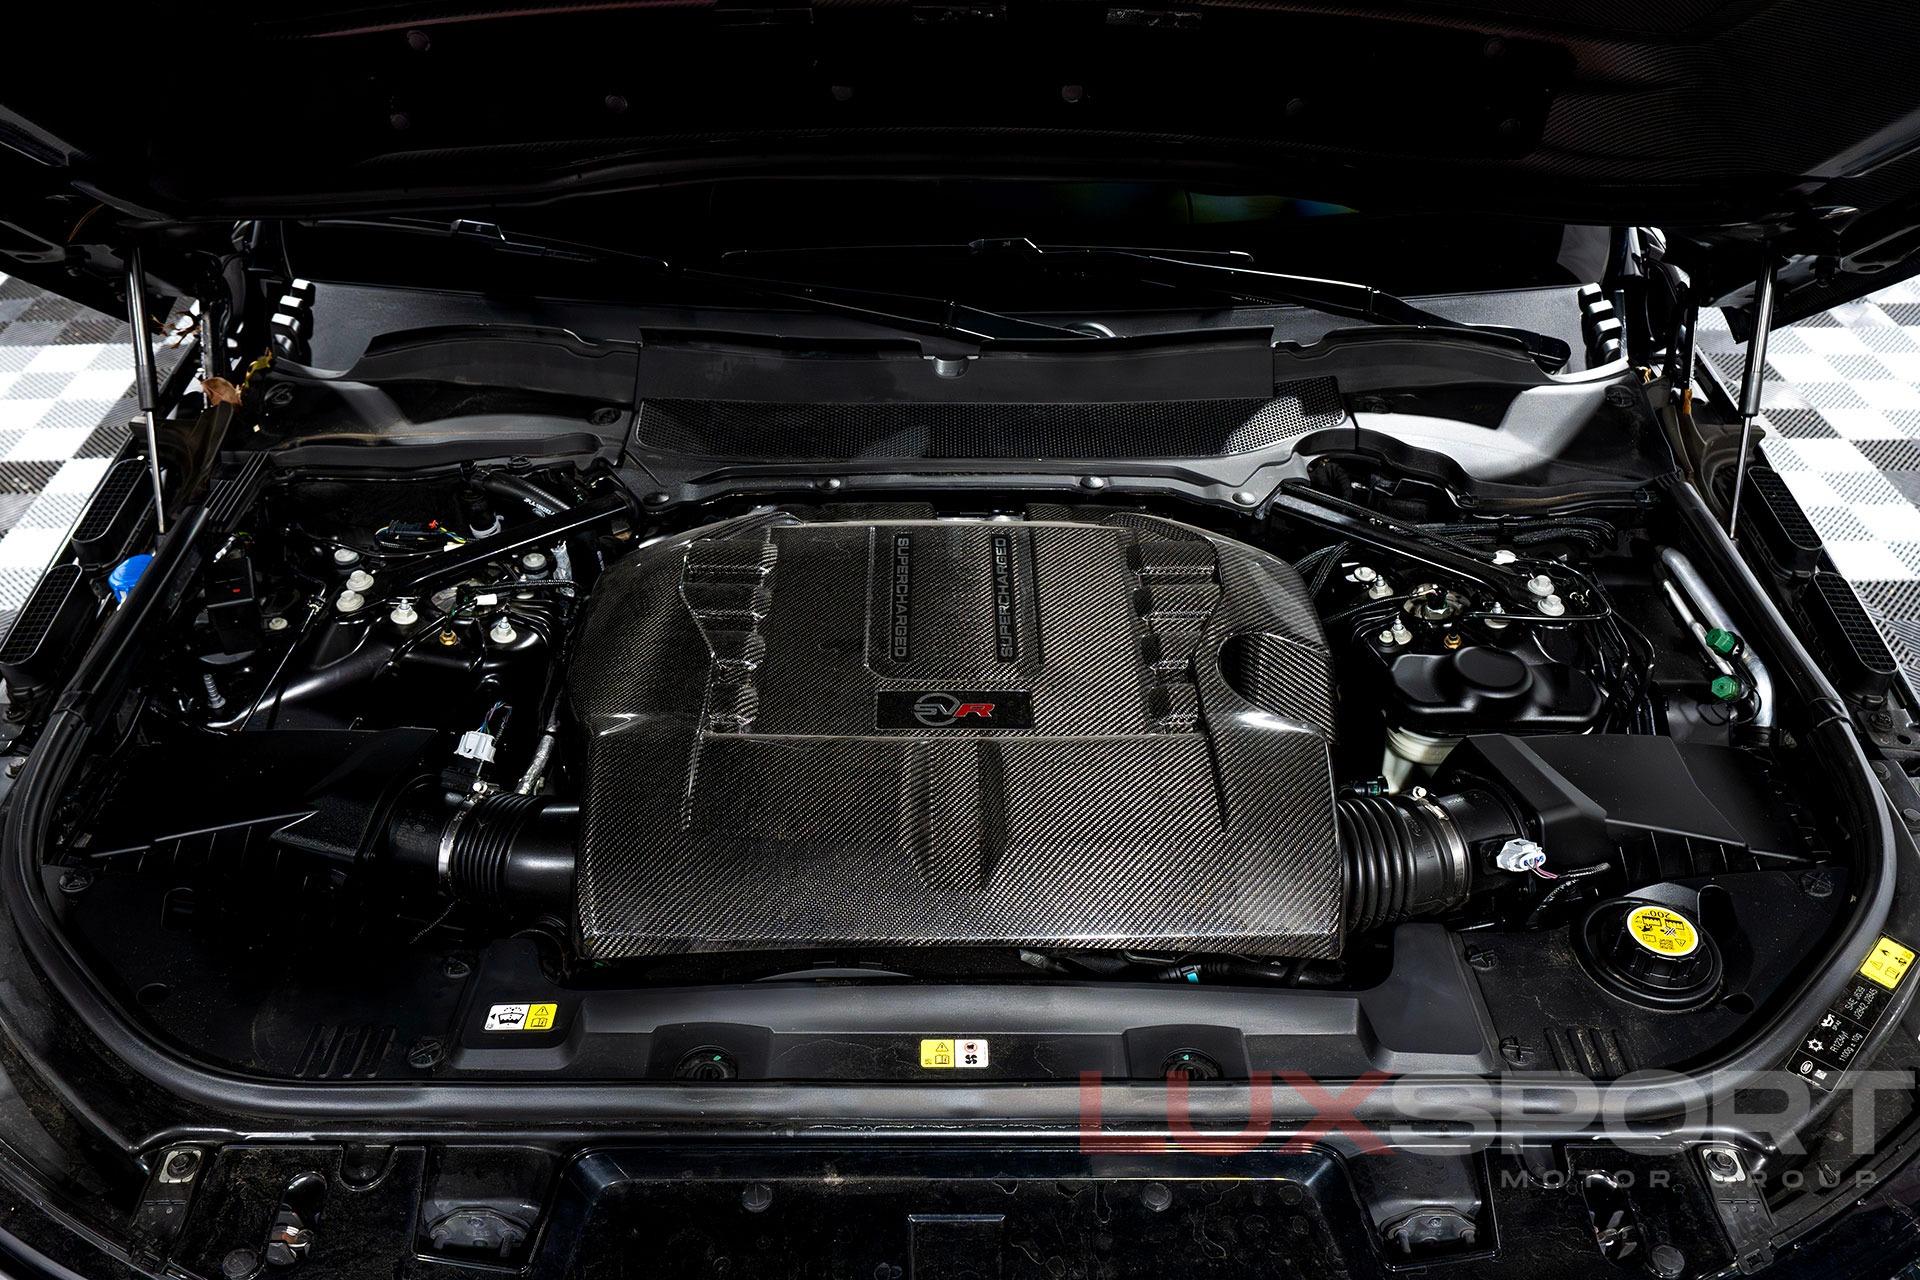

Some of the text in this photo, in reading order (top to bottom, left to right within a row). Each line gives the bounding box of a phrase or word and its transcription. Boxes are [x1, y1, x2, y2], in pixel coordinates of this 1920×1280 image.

[894, 537, 909, 657] SUPERCHARGED
[995, 537, 1013, 657] SUPERCHARGED
[1845, 998, 1858, 1011] SAE
